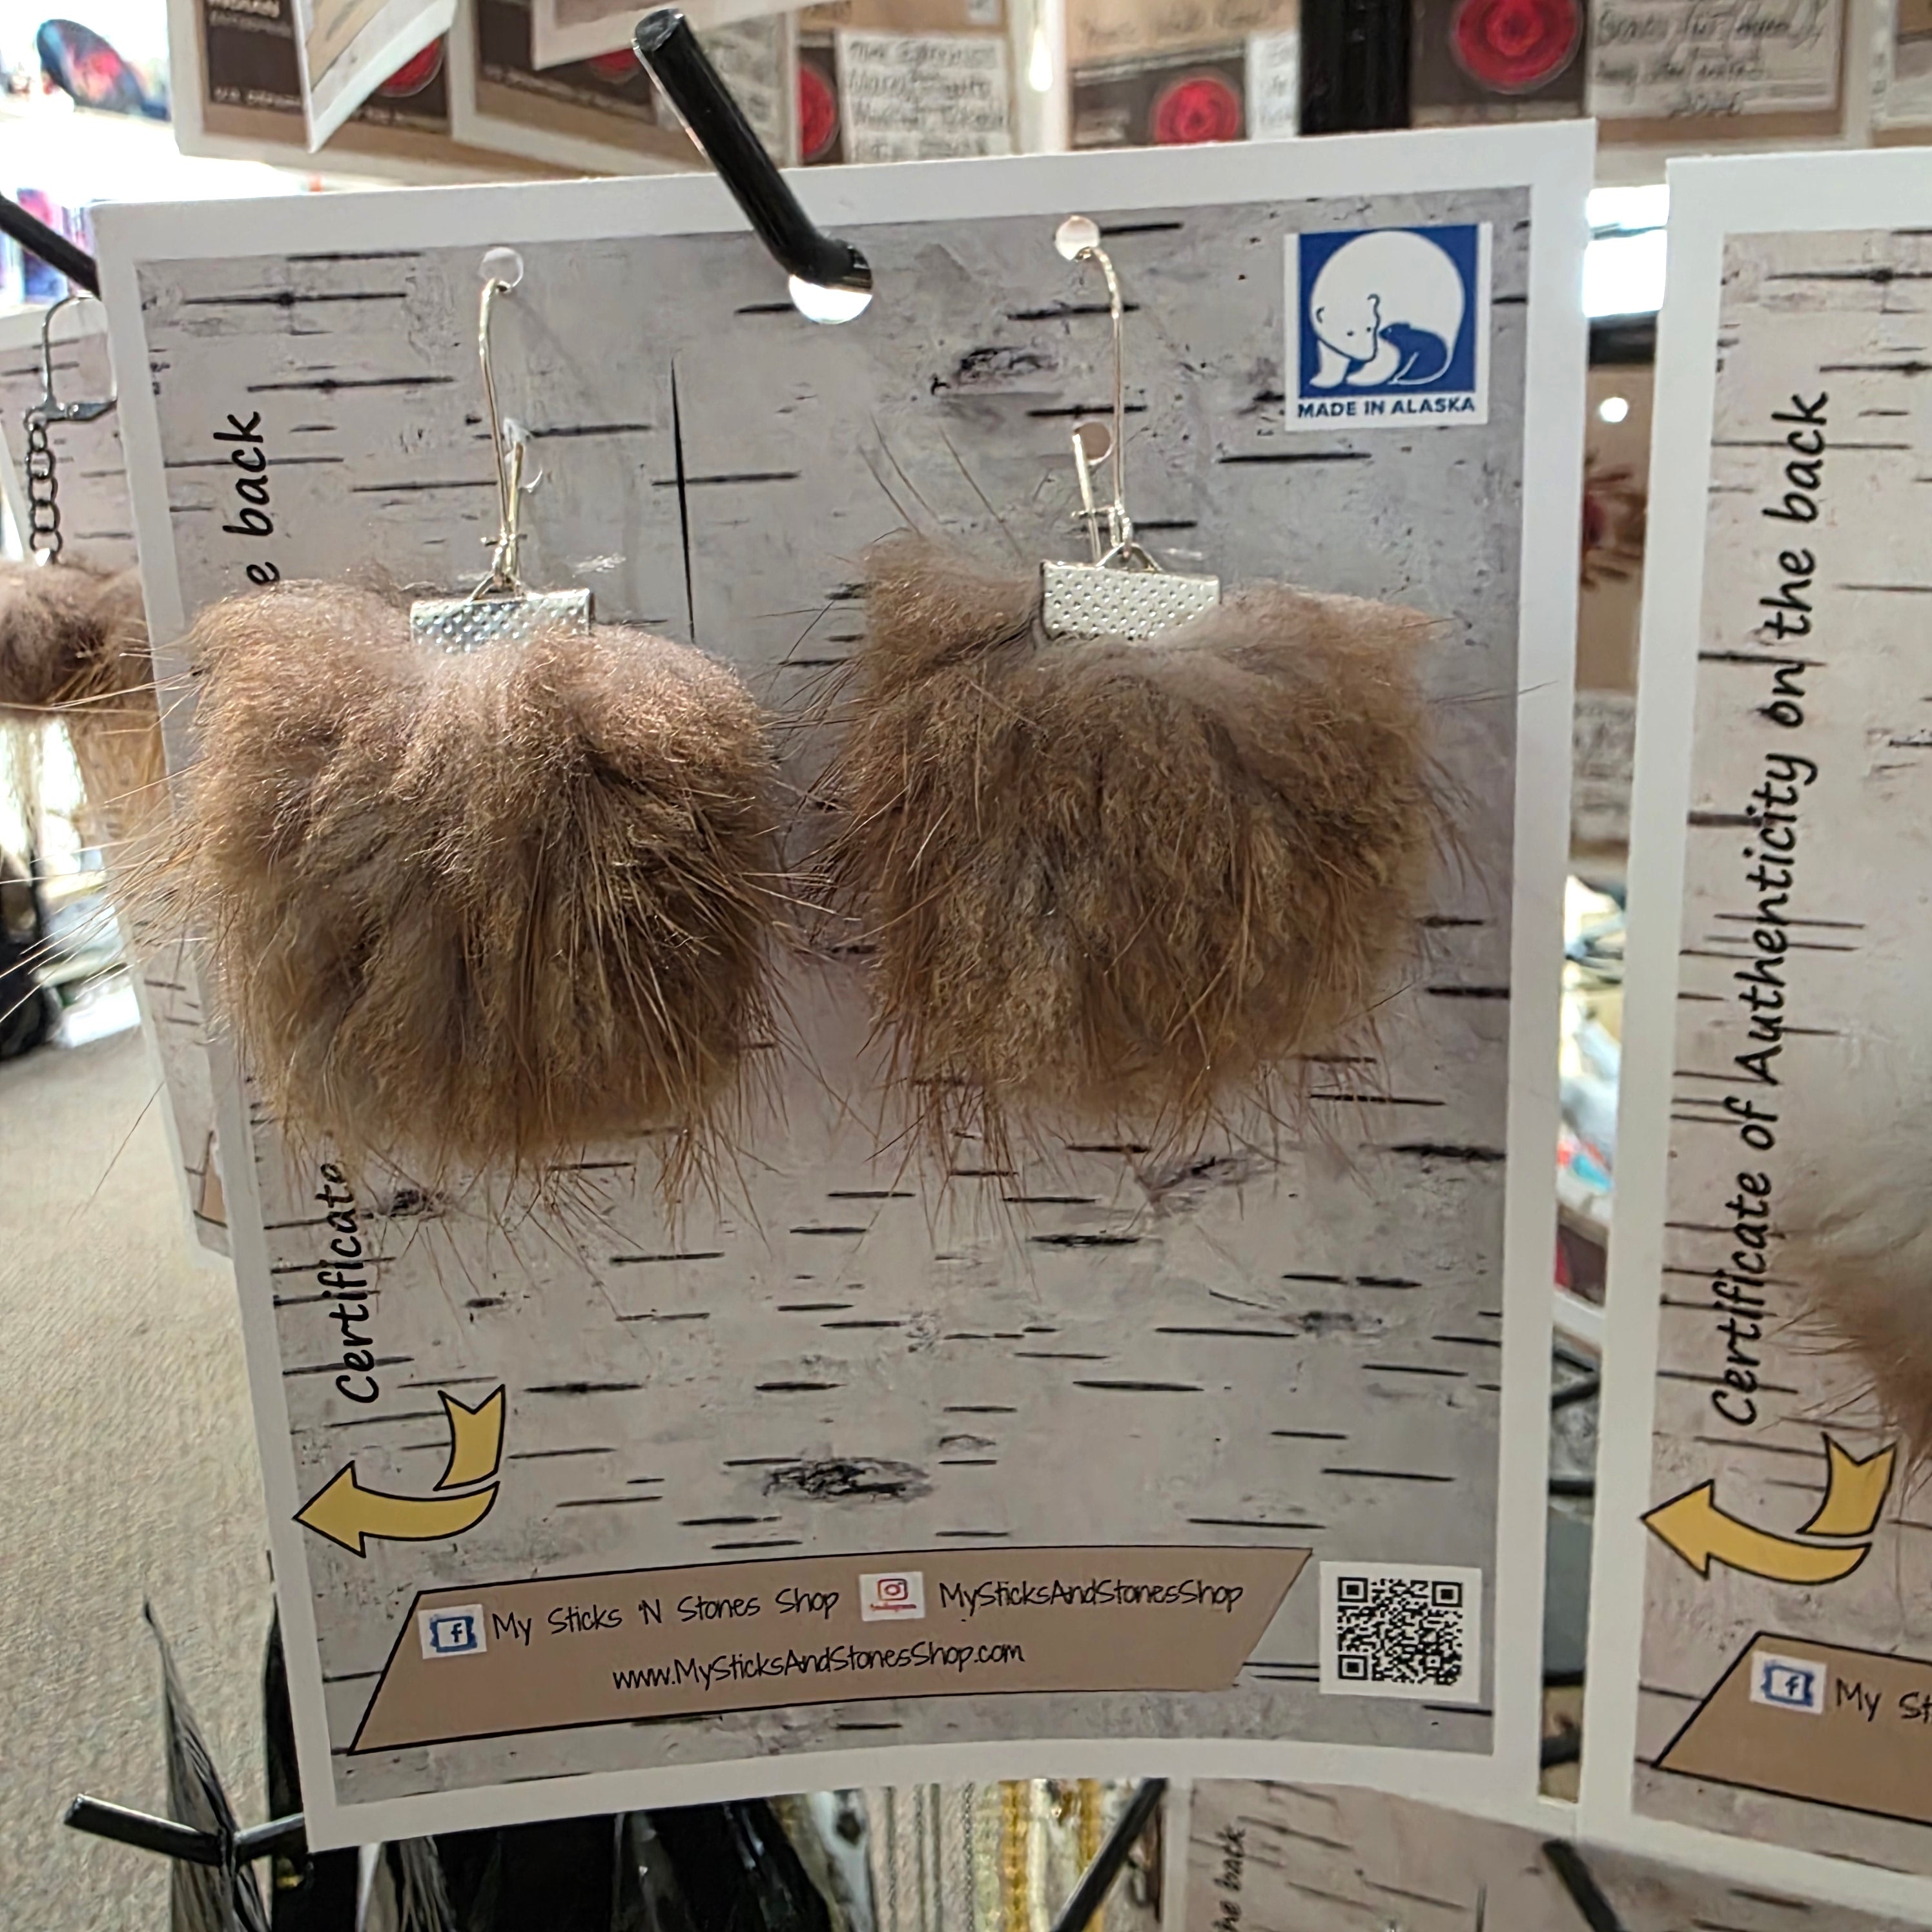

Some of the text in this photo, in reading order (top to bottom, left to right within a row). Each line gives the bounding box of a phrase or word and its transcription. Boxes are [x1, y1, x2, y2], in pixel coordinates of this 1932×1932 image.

[1298, 396, 1475, 418] MADE IN ALASKA
[213, 411, 274, 537] back
[1711, 391, 1829, 1425] Certificate of Authenticity on the back
[314, 1163, 379, 1404] Certificate
[492, 1614, 532, 1646] My
[547, 1604, 622, 1635] Sticks
[679, 1595, 761, 1622] Stones
[775, 1588, 839, 1619] Shop
[939, 1578, 1244, 1616] MySticksAndStonesShop
[613, 1641, 1026, 1691] www.MySticksAndStonesShop.com
[1836, 1677, 1882, 1722] My
